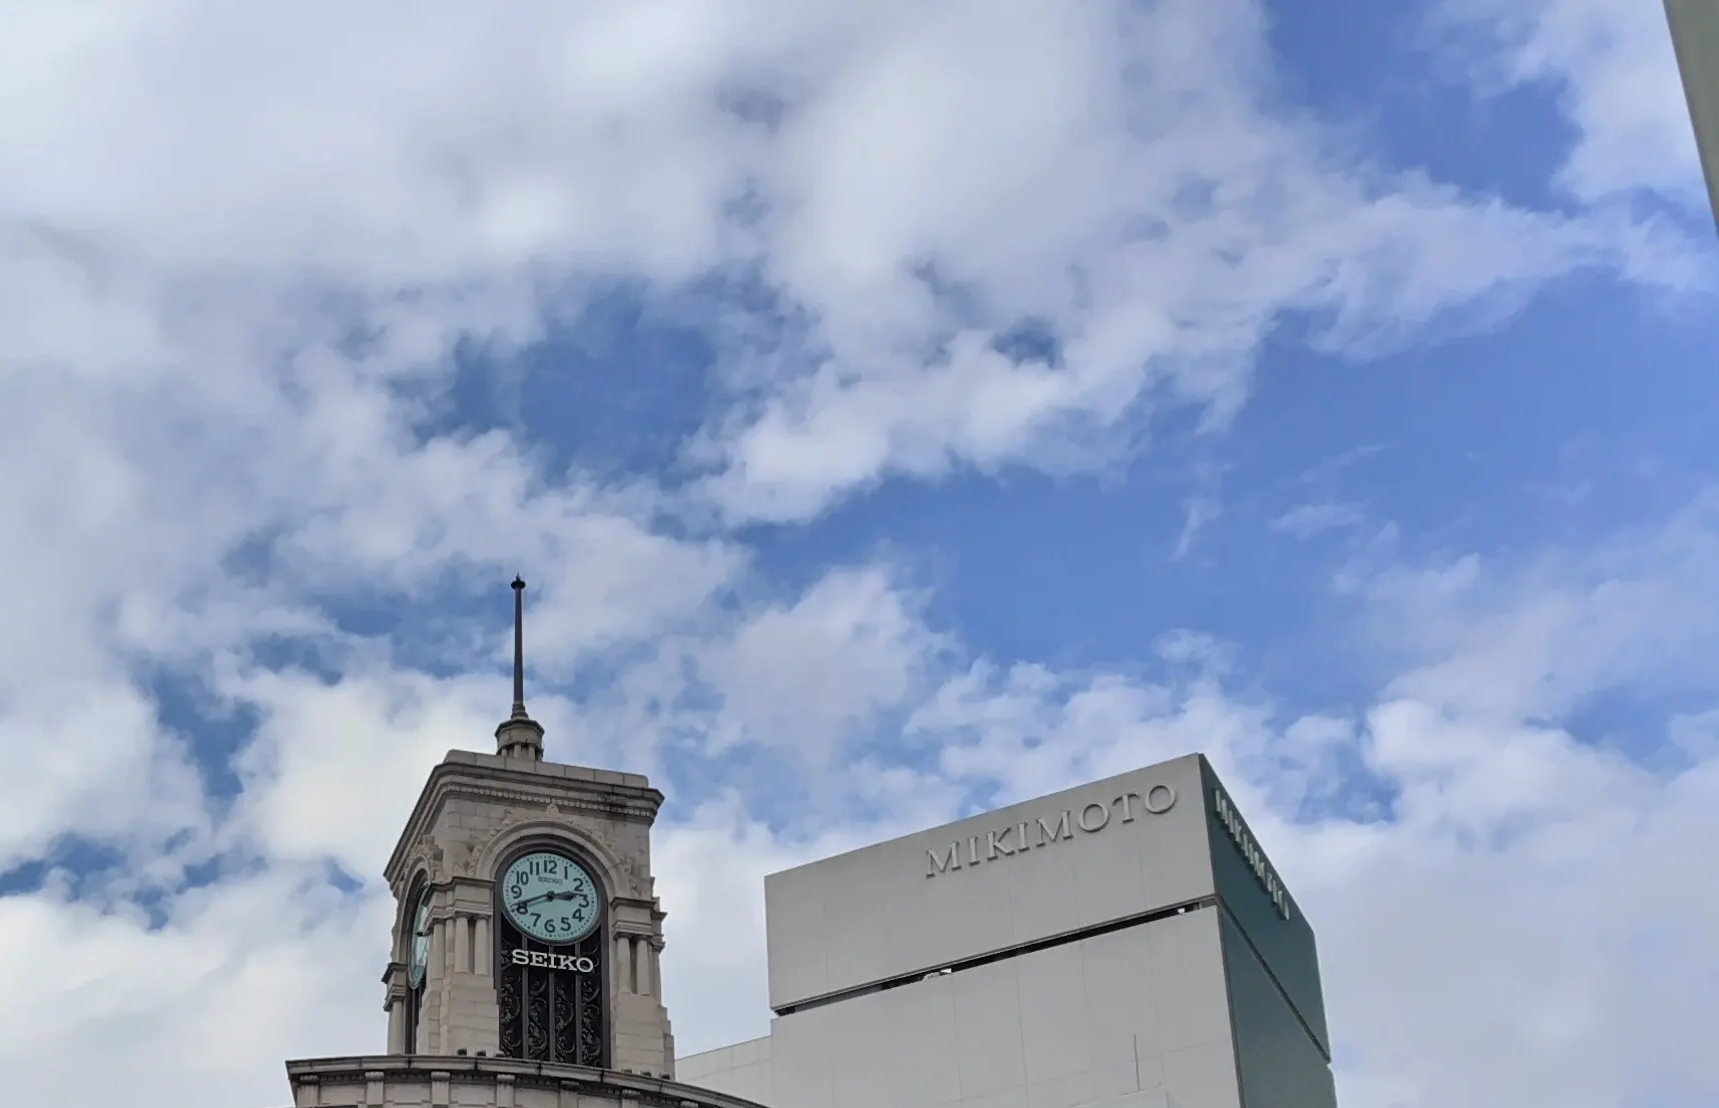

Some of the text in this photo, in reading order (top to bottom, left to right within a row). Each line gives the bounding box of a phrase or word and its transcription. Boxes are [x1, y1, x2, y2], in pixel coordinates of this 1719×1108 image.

[926, 785, 1177, 879] MIKIMOTO
[529, 861, 540, 875] 11
[543, 860, 557, 874] 12
[564, 865, 569, 880] 1
[516, 871, 529, 885] 10
[573, 877, 584, 892] 2
[510, 884, 522, 899] 9
[516, 901, 529, 915] 8
[578, 894, 590, 908] 3
[530, 912, 541, 927] 7
[572, 908, 585, 922] 4
[544, 919, 556, 933] 6
[560, 917, 571, 931] 5
[512, 948, 594, 973] SEIKO
